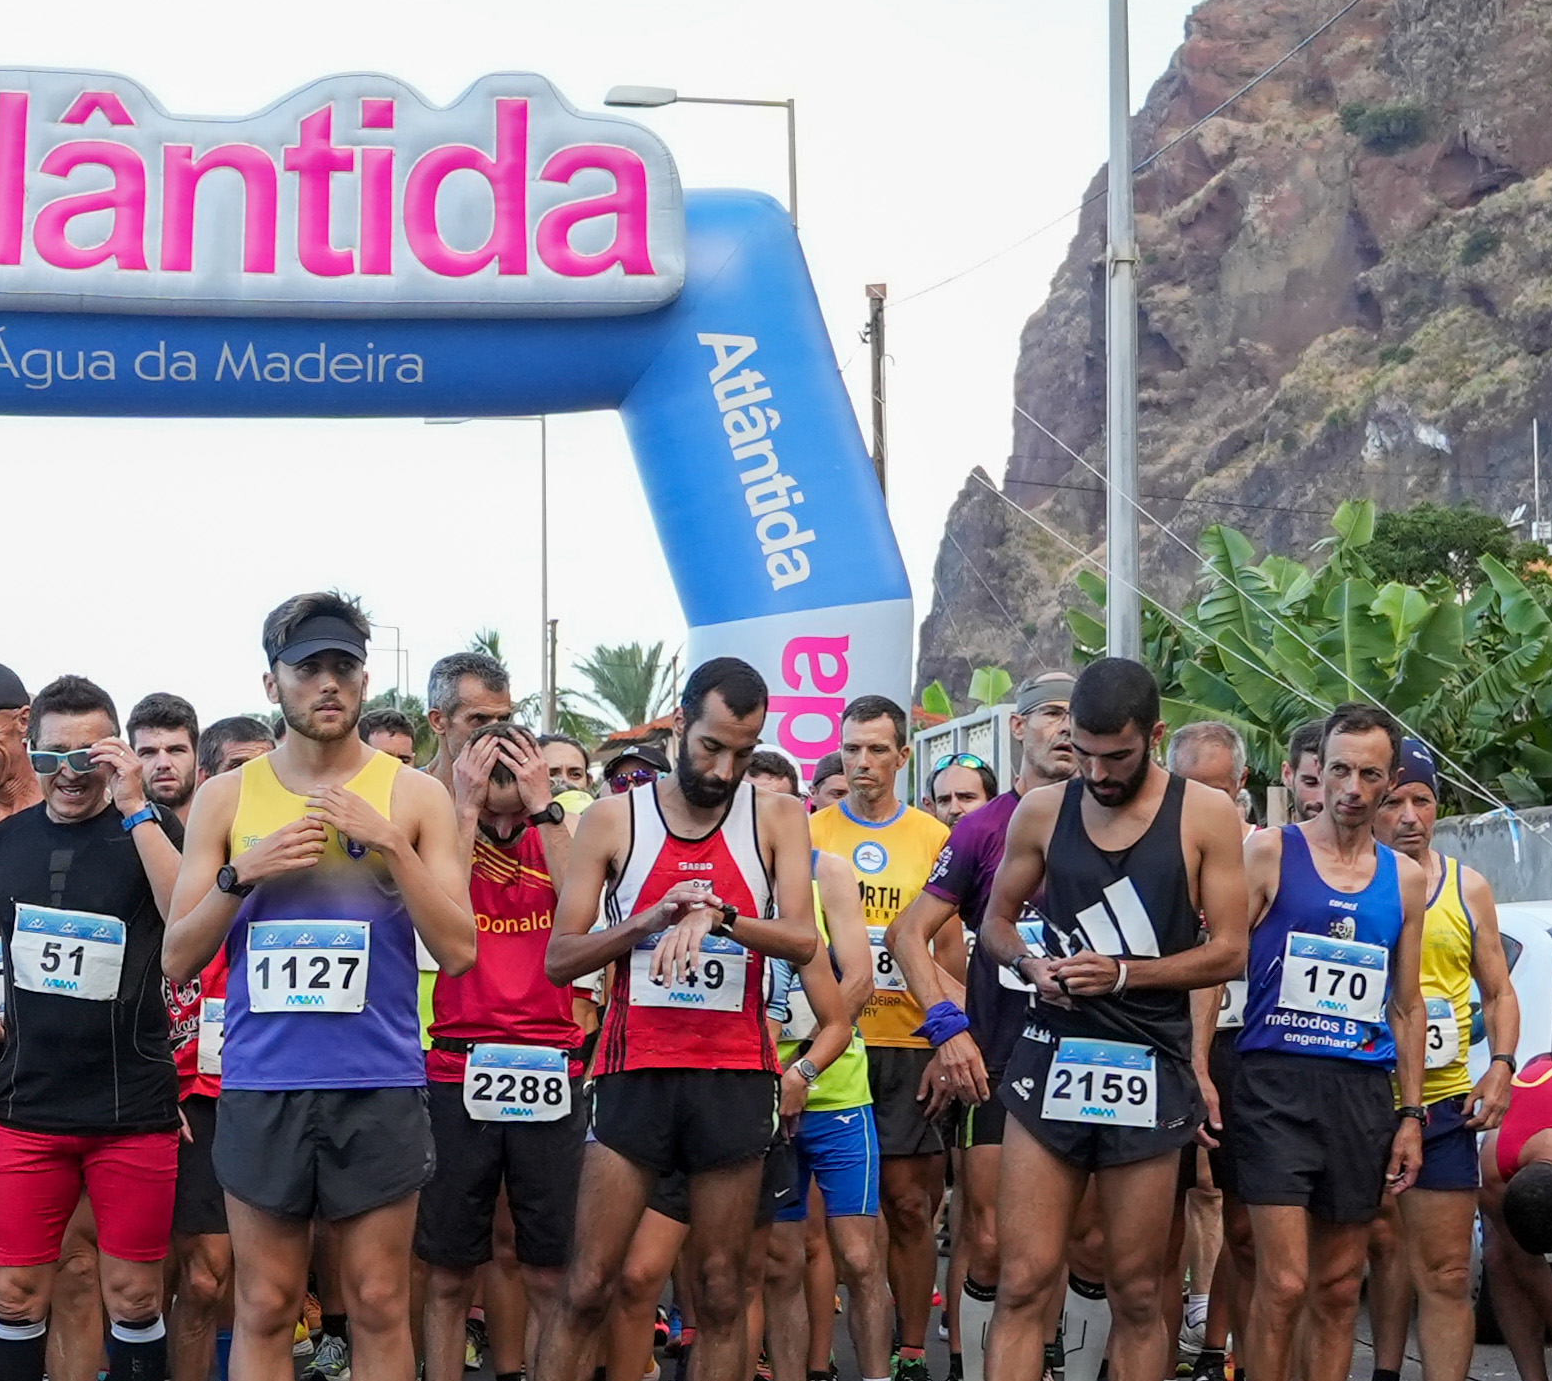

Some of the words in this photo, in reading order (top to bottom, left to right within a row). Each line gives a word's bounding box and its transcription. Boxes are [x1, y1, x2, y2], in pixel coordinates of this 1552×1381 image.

[135, 340, 195, 382] da
[216, 342, 425, 386] Madeira
[696, 332, 816, 591] Atlântida
[475, 909, 552, 933] Donald
[40, 942, 85, 977] 51
[255, 957, 359, 990] 1127
[653, 959, 724, 989] 49
[1304, 965, 1367, 1000] 170
[1265, 1012, 1340, 1032] métodos
[1345, 1021, 1357, 1036] B
[1284, 1032, 1357, 1049] engenharia
[472, 1073, 563, 1105] 2288
[1052, 1069, 1147, 1105] 2159
